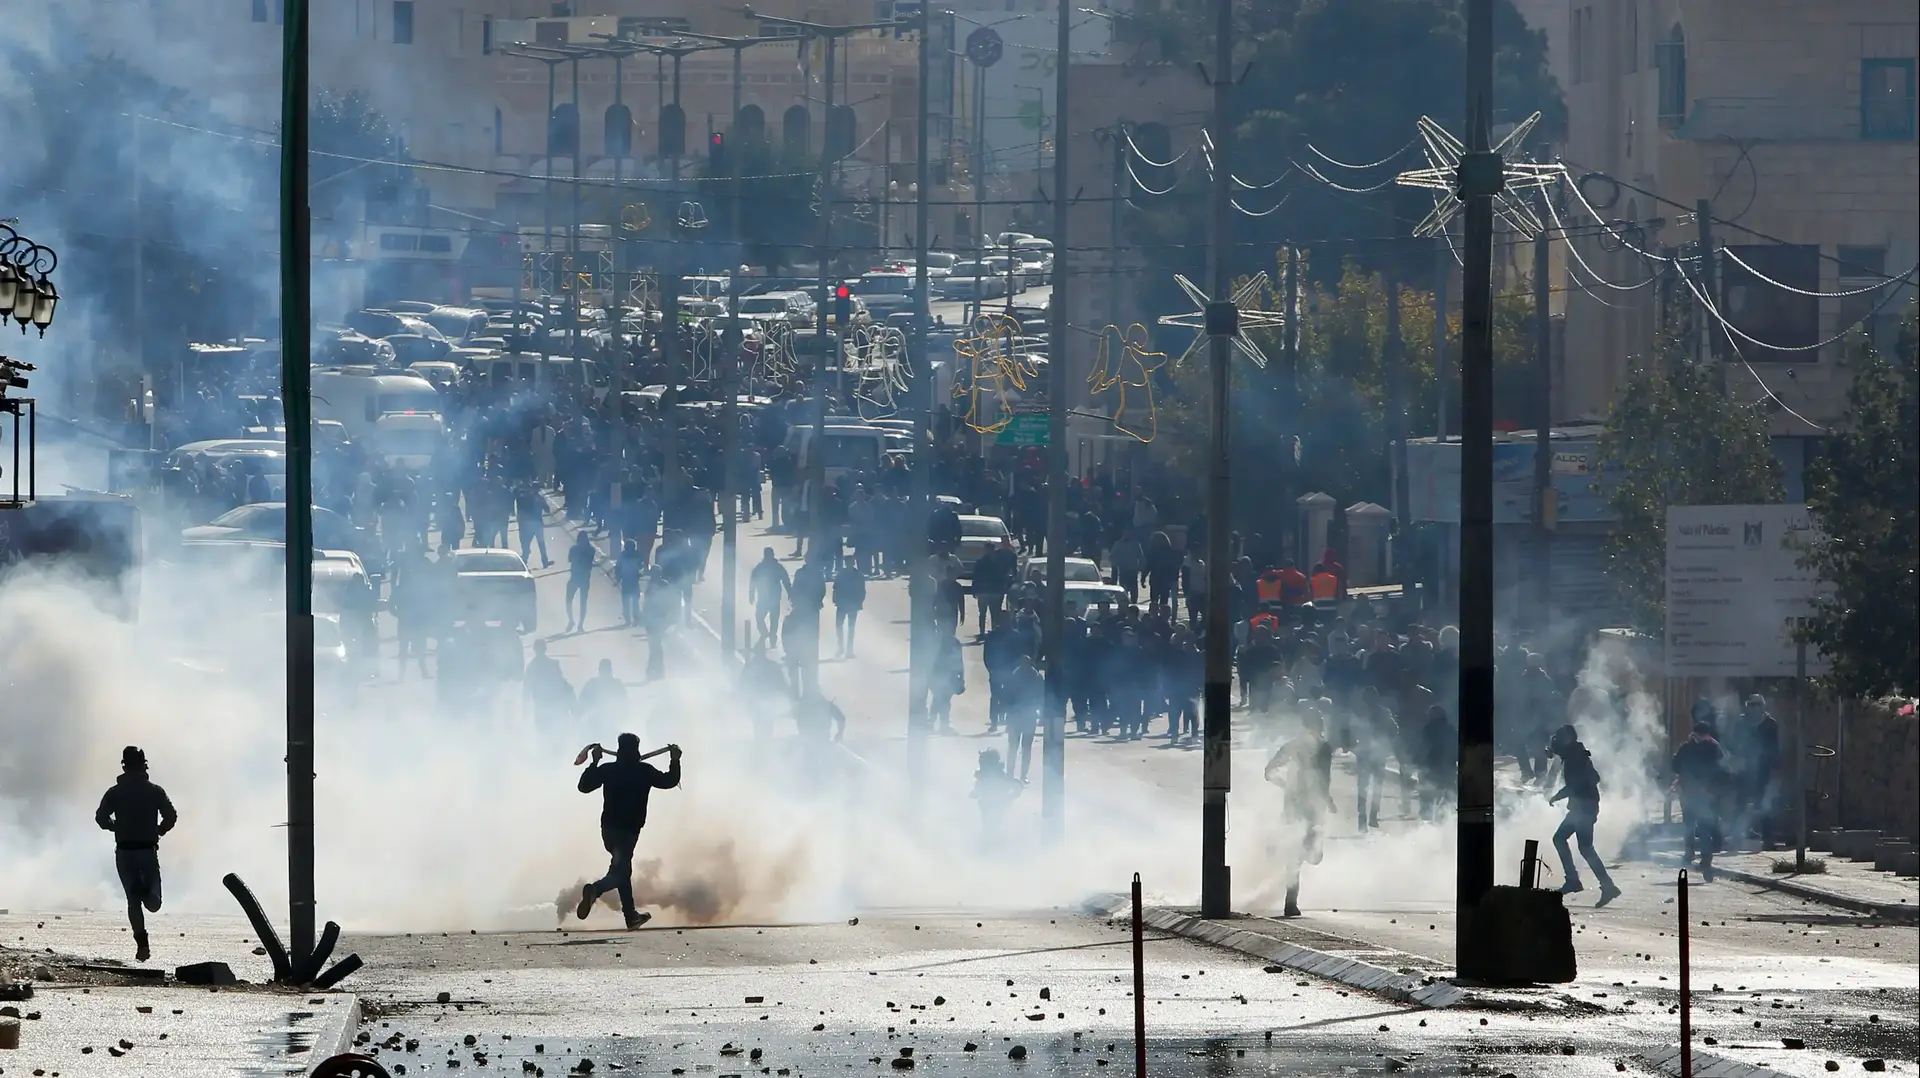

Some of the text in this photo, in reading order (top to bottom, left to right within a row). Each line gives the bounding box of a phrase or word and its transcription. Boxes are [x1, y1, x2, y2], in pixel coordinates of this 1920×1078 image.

[1556, 455, 1588, 463] ALDO
[1694, 523, 1702, 536] of
[1702, 523, 1731, 536] Palestine
